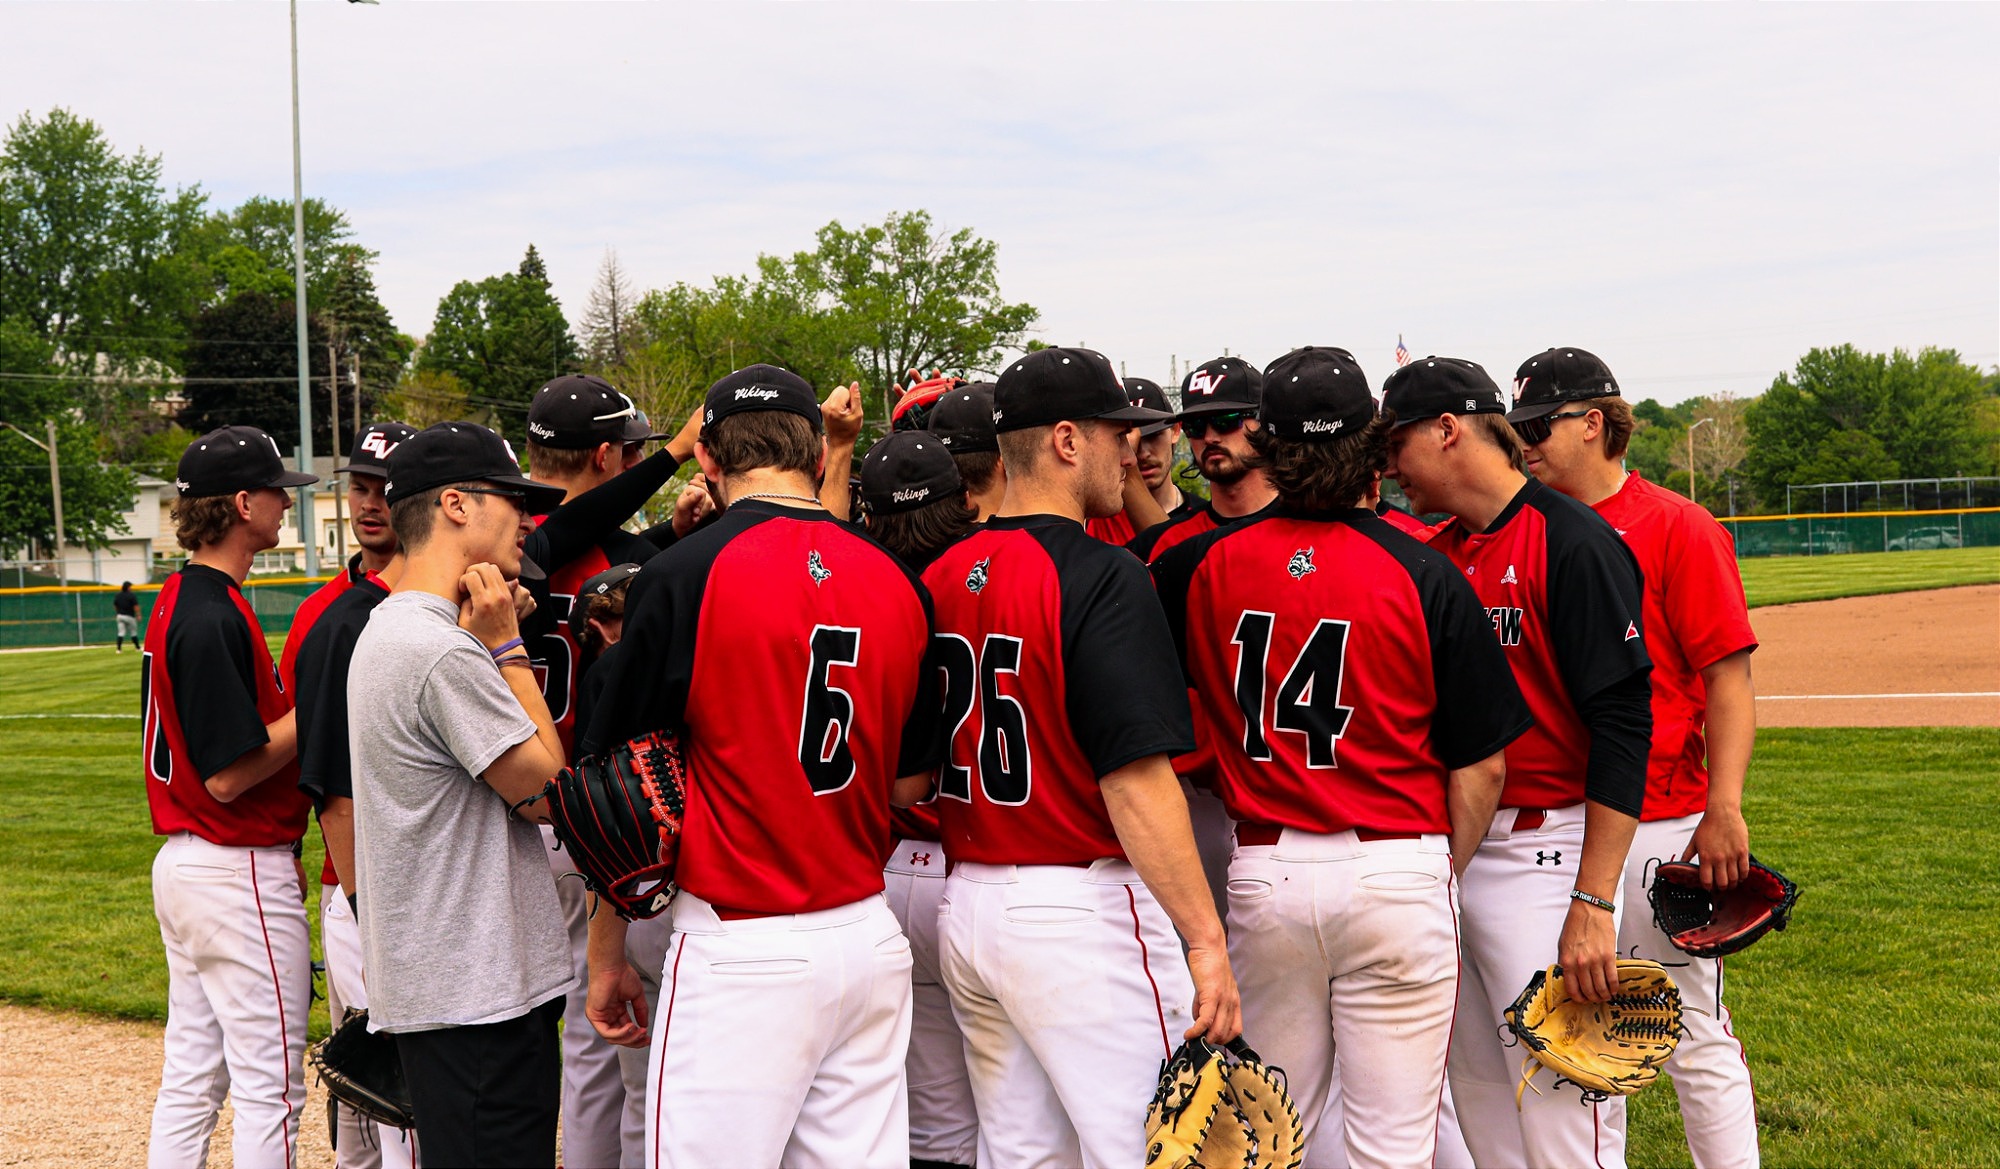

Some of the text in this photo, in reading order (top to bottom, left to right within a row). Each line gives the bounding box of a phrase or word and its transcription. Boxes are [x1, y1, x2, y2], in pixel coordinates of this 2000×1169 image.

[734, 385, 780, 401] Vikings
[529, 421, 556, 440] Vikings
[1302, 418, 1344, 434] Vikings
[892, 487, 930, 503] Vikings
[1229, 608, 1355, 769] 14
[797, 623, 862, 796] 6
[934, 632, 1032, 806] 26
